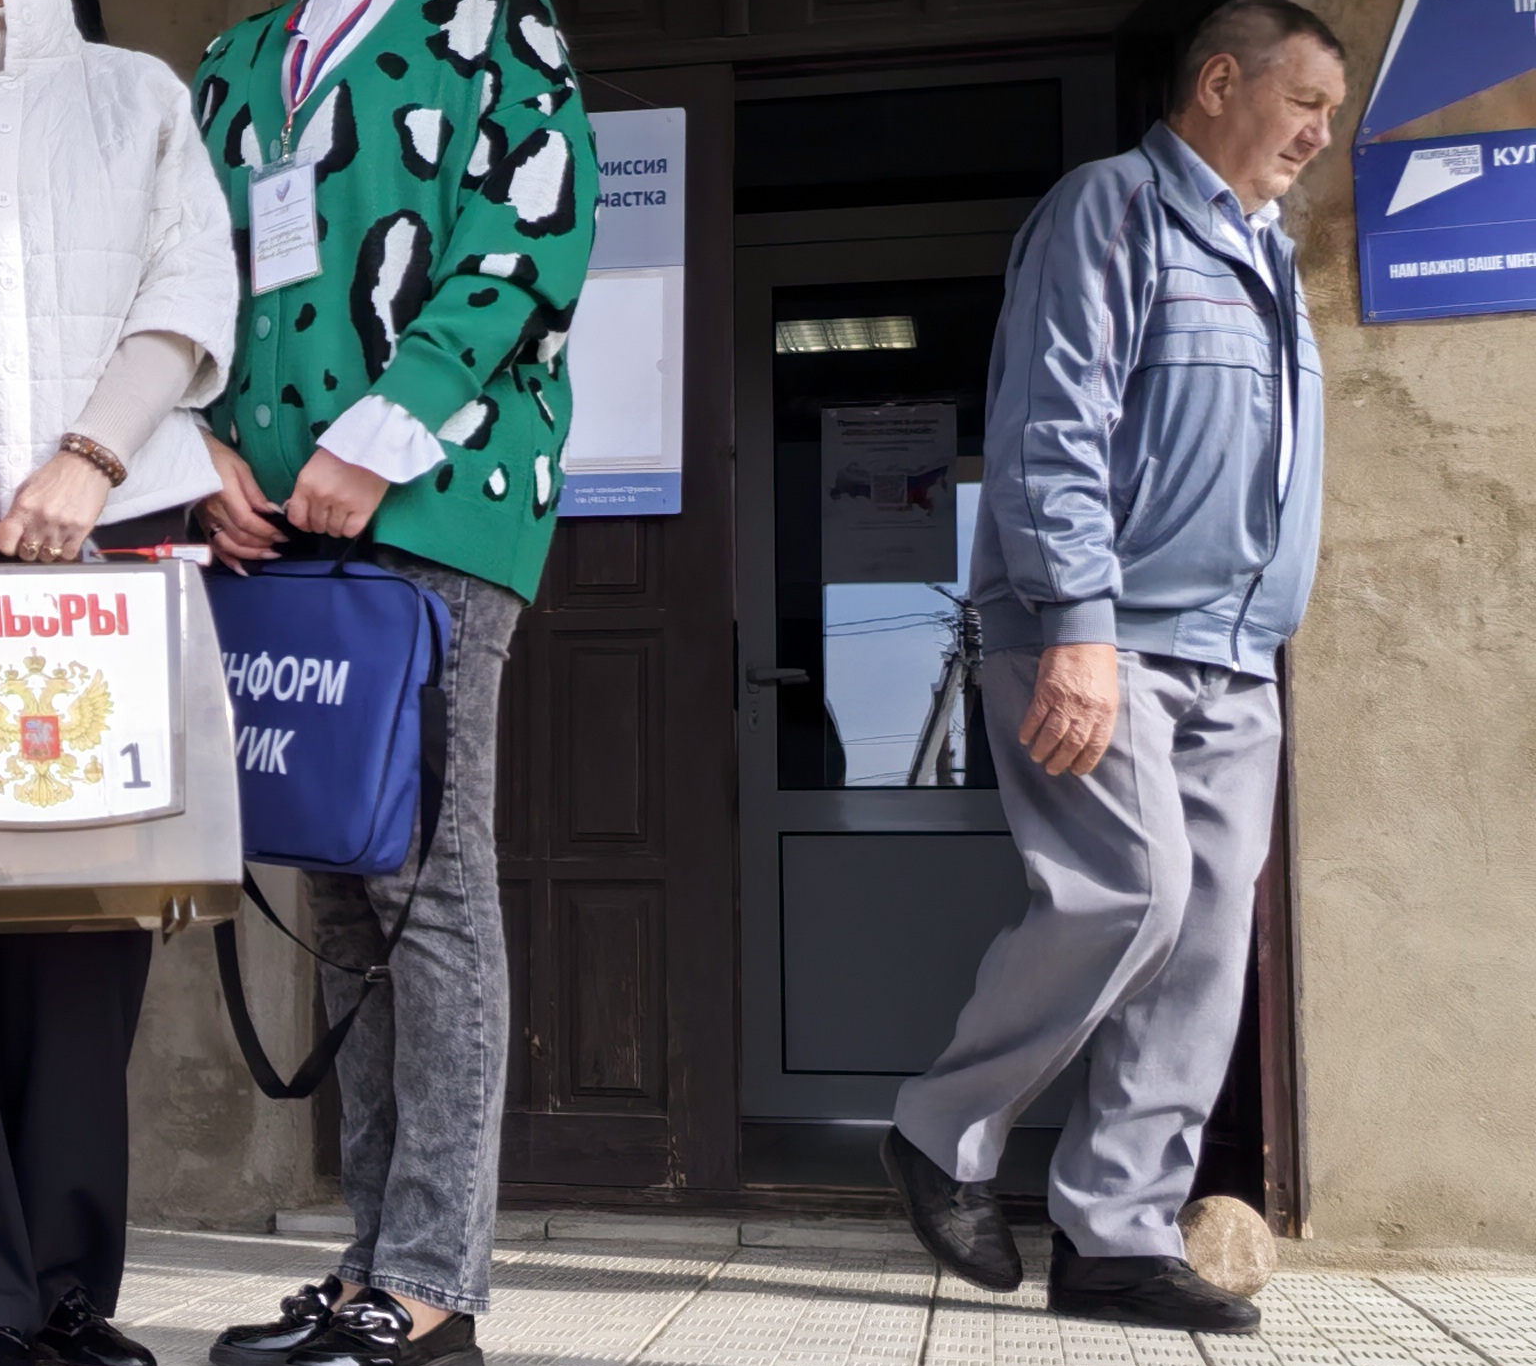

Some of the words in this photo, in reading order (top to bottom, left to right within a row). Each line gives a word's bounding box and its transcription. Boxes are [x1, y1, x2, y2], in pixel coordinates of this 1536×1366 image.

[1389, 263, 1418, 279] НАМ
[1420, 258, 1464, 276] ВАЖНО
[1467, 255, 1504, 272] ВАШЕ
[119, 742, 151, 789] 1
